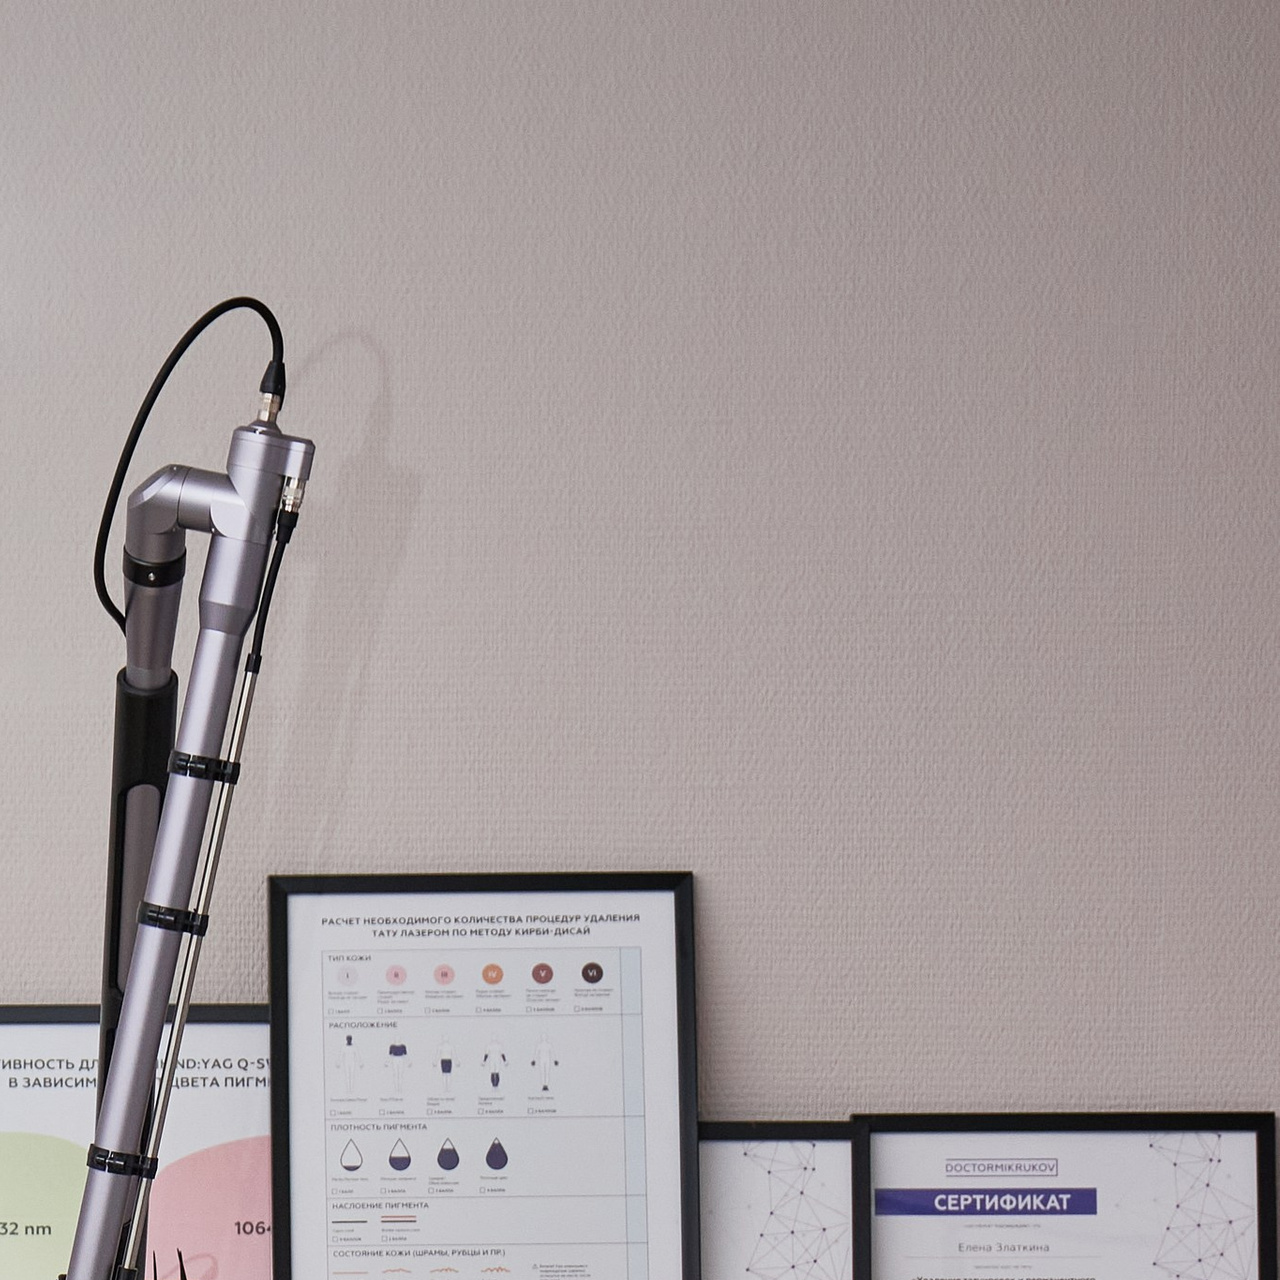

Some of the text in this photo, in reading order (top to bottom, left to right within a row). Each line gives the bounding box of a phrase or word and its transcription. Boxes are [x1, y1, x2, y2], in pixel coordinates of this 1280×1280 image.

[321, 913, 641, 926] РАСЧЕТ НЕОБХОДИМОГО КОЛИЧЕСТВА ПРОЦЕДУР УДАЛЕНИЯ
[372, 925, 591, 938] ТАТУ ЛАЗЕРОМ ПО МЕТОДУ КИРБИ-ДИСАЙ
[328, 954, 372, 962] ТИП КОЖИ
[328, 1021, 398, 1030] РАСПОЛОЖЕНИЕ
[78, 1059, 99, 1072] ДЛ
[175, 1058, 233, 1070] ND:YAG
[238, 1058, 271, 1071] Q-S
[8, 1077, 97, 1089] В ЗАВИСИМ
[224, 1077, 271, 1088] ПИГМ
[330, 1122, 428, 1132] ПЛОТНОСТЬ ПИГМЕНТА
[945, 1162, 1056, 1173] DOCTORMIKRUKOV
[332, 1201, 430, 1210] НАСЛОЕНИЕ ПИГМЕНТА
[933, 1193, 1071, 1212] СЕРТИФИКАТ
[24, 1223, 52, 1236] nm
[332, 1250, 384, 1258] СОСТОЯНИЕ
[385, 1249, 411, 1258] КОЖИ
[452, 1248, 481, 1258] РУБЦЫ
[482, 1248, 489, 1256] И
[958, 1242, 1050, 1253] Елена Златкина
